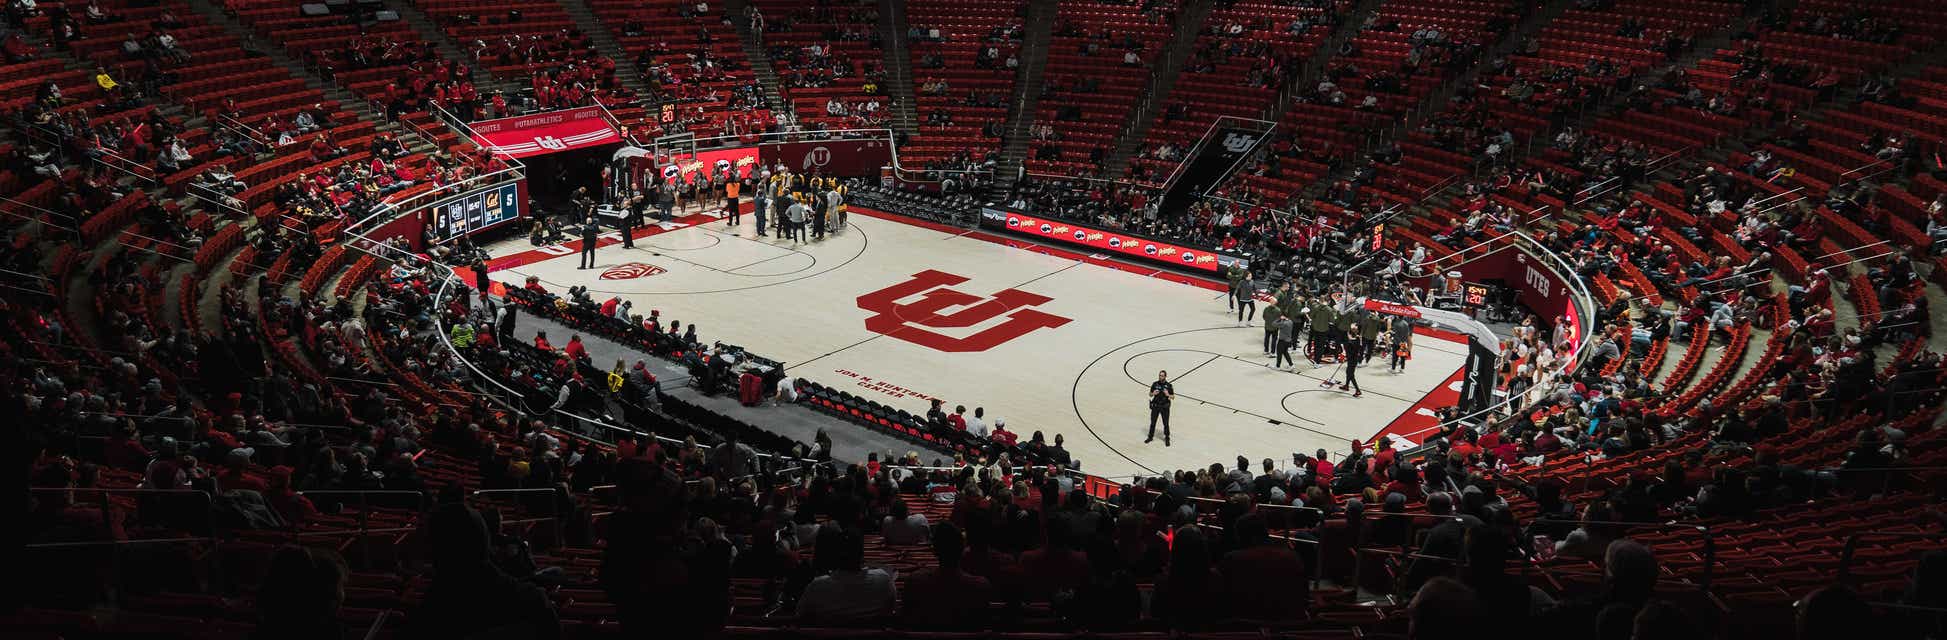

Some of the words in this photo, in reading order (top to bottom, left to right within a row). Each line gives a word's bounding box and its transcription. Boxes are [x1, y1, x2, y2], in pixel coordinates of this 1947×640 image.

[662, 111, 673, 122] 20
[506, 193, 513, 207] 5
[439, 215, 446, 229] 5
[1526, 265, 1550, 298] UTES
[1470, 294, 1482, 304] 20
[834, 369, 860, 379] JON
[857, 381, 905, 399] CENTER
